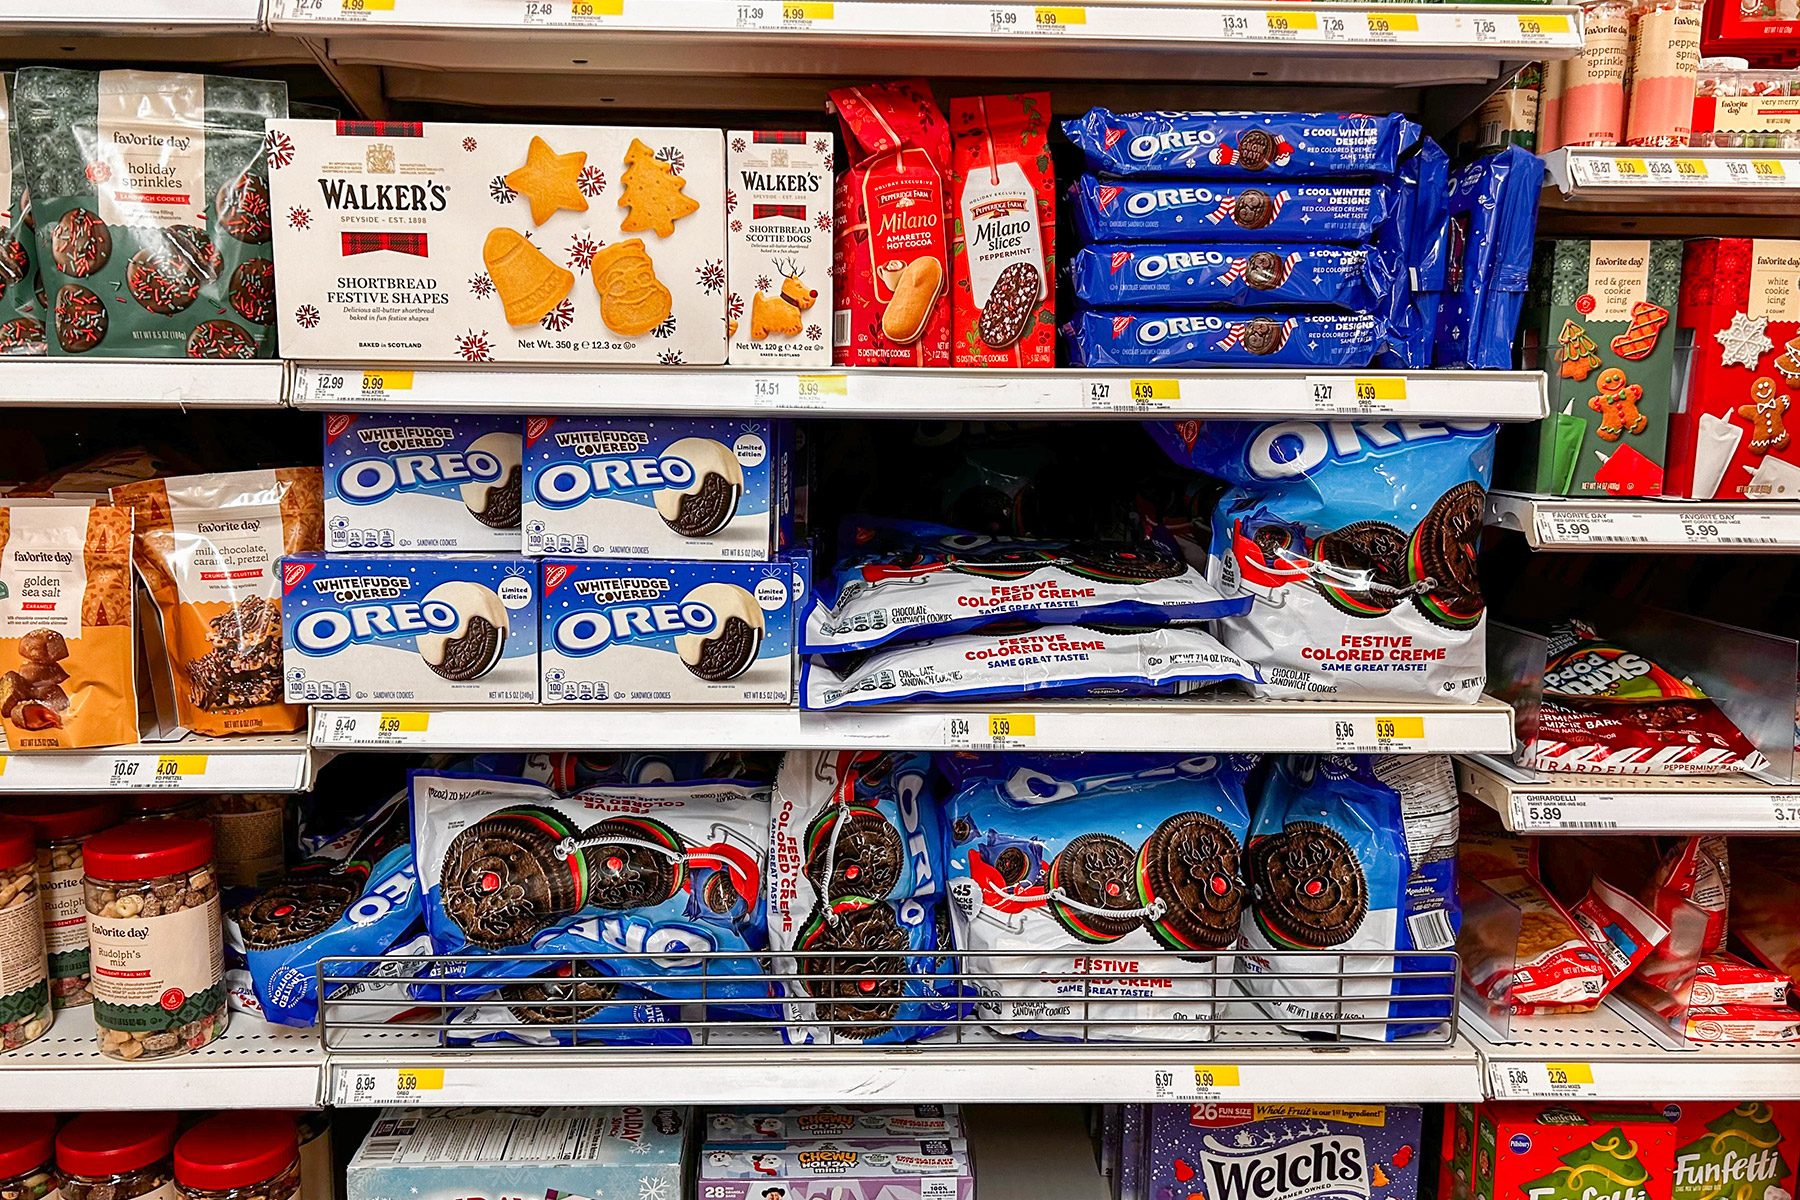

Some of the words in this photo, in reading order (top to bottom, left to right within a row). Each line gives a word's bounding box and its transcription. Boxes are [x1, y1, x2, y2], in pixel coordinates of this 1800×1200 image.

[525, 3, 552, 15] 12.48
[571, 4, 593, 15] 4.99
[737, 7, 763, 18] 11.39
[783, 8, 804, 19] 4.99
[991, 13, 1016, 24] 15.99
[1035, 13, 1056, 24] 4.99
[1222, 17, 1248, 28] 13.31
[1266, 18, 1288, 29] 4.99
[1323, 19, 1344, 31] 7.26
[1367, 20, 1389, 31] 2.99
[1473, 21, 1496, 32] 7.85
[1518, 22, 1541, 33] 2.99
[1761, 99, 1776, 107] very
[113, 131, 163, 147] favorite
[166, 133, 191, 151] day
[1128, 130, 1217, 158] OREO
[1335, 137, 1377, 146] DESIGNS
[128, 162, 177, 177] holiday
[1590, 163, 1611, 173] 18.87
[1727, 164, 1748, 174] 18.87
[123, 175, 183, 190] sprinkles
[880, 191, 911, 203] PEPPERIDGE
[912, 190, 929, 200] FARM
[1125, 187, 1213, 216] OREO
[1329, 197, 1371, 205] DESIGNS
[974, 203, 1006, 216] PEPPERIDGE
[1006, 200, 1025, 211] FARM
[749, 224, 811, 235] SHORTBREAD
[876, 213, 938, 236] Milano
[745, 233, 780, 243] SCOTTIE
[781, 234, 812, 244] DOGS
[886, 231, 932, 243] AMARETTO
[972, 221, 1032, 247] Milano
[886, 240, 904, 250] HOT
[904, 238, 934, 248] COCOA
[988, 236, 1020, 251] slices
[979, 247, 1032, 262] PEPPERMINT
[1136, 250, 1224, 280] OREO
[1595, 256, 1626, 266] favorite
[1628, 257, 1644, 268] day
[337, 277, 438, 290] SHORTBREAD
[1595, 277, 1609, 286] red
[1611, 278, 1619, 286] &
[1621, 278, 1641, 288] green
[1767, 277, 1788, 286] white
[327, 291, 389, 304] FESTIVE
[392, 292, 449, 304] SHAPES
[1604, 286, 1631, 296] cookie
[1764, 286, 1789, 296] cookie
[1606, 296, 1627, 307] icing
[1766, 296, 1786, 307] icing
[343, 306, 370, 315] Delicious
[372, 307, 400, 315] all-butter
[402, 307, 435, 315] shortbread
[1137, 315, 1224, 345] OREO
[518, 340, 534, 349] Net
[535, 340, 555, 349] Wt.
[555, 341, 571, 350] 350
[573, 342, 580, 352] g
[591, 341, 610, 350] 12.3
[317, 376, 344, 389] 12.99
[362, 377, 384, 389] 9.99
[1091, 385, 1110, 398] 4.27
[1134, 385, 1154, 398] 4.99
[1313, 385, 1333, 398] 4.27
[1356, 386, 1376, 399] 4.99
[360, 428, 404, 441] WHITE
[405, 428, 453, 440] FUDGE
[557, 433, 602, 446] WHITE
[603, 432, 648, 443] FUDGE
[380, 438, 442, 451] COVERED
[577, 442, 637, 455] COVERED
[736, 444, 763, 452] Limited
[737, 451, 762, 459] Edition
[340, 450, 500, 498] OREO
[537, 458, 693, 504] OREO
[198, 521, 239, 533] favorite
[240, 520, 262, 534] day
[1556, 523, 1591, 535] 5.99
[1685, 524, 1719, 536] 5.99
[14, 551, 53, 562] favorite
[54, 552, 73, 565] day
[24, 575, 60, 588] golden
[314, 579, 362, 592] WHITE
[363, 578, 410, 590] FUDGE
[576, 581, 622, 594] WHITE
[622, 580, 668, 590] FUDGE
[991, 580, 1058, 596] FESTIVE
[22, 587, 40, 598] sea
[42, 586, 62, 598] salt
[335, 588, 400, 602] COVERED
[501, 586, 529, 595] Limited
[597, 589, 659, 602] COVERED
[757, 588, 784, 596] Limited
[957, 588, 1035, 608] COLORED
[1038, 586, 1097, 600] CREME
[502, 593, 528, 602] Edition
[758, 595, 784, 603] Edition
[295, 602, 457, 653] OREO
[556, 603, 715, 652] OREO
[998, 634, 1067, 648] FESTIVE
[1341, 634, 1413, 648] FESTIVE
[965, 643, 1044, 660] COLORED
[1047, 641, 1107, 653] CREME
[1301, 647, 1387, 662] COLORED
[1389, 647, 1447, 661] CREME
[987, 659, 1018, 668] SAME
[1018, 655, 1054, 665] GREAT
[1054, 653, 1090, 664] TASTE!
[1321, 663, 1352, 671] SAME
[1354, 663, 1390, 672] GREAT
[1391, 663, 1428, 672] TASTE!
[1271, 667, 1311, 682] CHOCOLATE
[1270, 675, 1306, 692] SANDWICH
[1307, 682, 1338, 694] COOKIES
[335, 719, 356, 731] 9.40
[379, 719, 401, 732] 4.99
[951, 720, 970, 735] 8.94
[992, 720, 1010, 735] 3.99
[1336, 723, 1355, 738] 6.96
[1377, 723, 1395, 738] 9.99
[113, 762, 140, 776] 10.67
[156, 762, 178, 776] 4.00
[1529, 807, 1563, 820] 5.89
[775, 800, 794, 876] COLORED
[952, 884, 972, 897] 45
[780, 877, 802, 933] CREME
[91, 922, 127, 939] favorite
[127, 926, 150, 941] day
[98, 948, 141, 960] Rudolph's
[109, 959, 127, 968] mix
[1074, 958, 1139, 973] FESTIVE
[1155, 1073, 1173, 1087] 6.97
[1194, 1073, 1214, 1087] 9.99
[1508, 1070, 1528, 1084] 5.86
[1548, 1070, 1568, 1084] 2.29
[355, 1077, 376, 1091] 8.95
[396, 1077, 417, 1091] 3.99
[1193, 1103, 1217, 1120] 26
[1218, 1107, 1234, 1117] FUN
[1235, 1107, 1252, 1117] SIZE
[1256, 1106, 1286, 1116] Whole
[1287, 1106, 1312, 1116] Fruit
[1318, 1109, 1331, 1117] our
[800, 1151, 857, 1164] CHEWY
[801, 1160, 859, 1170] HOLIDAY
[813, 1167, 847, 1175] minis
[1674, 1148, 1779, 1187] Funfetti
[704, 1187, 727, 1198] 28
